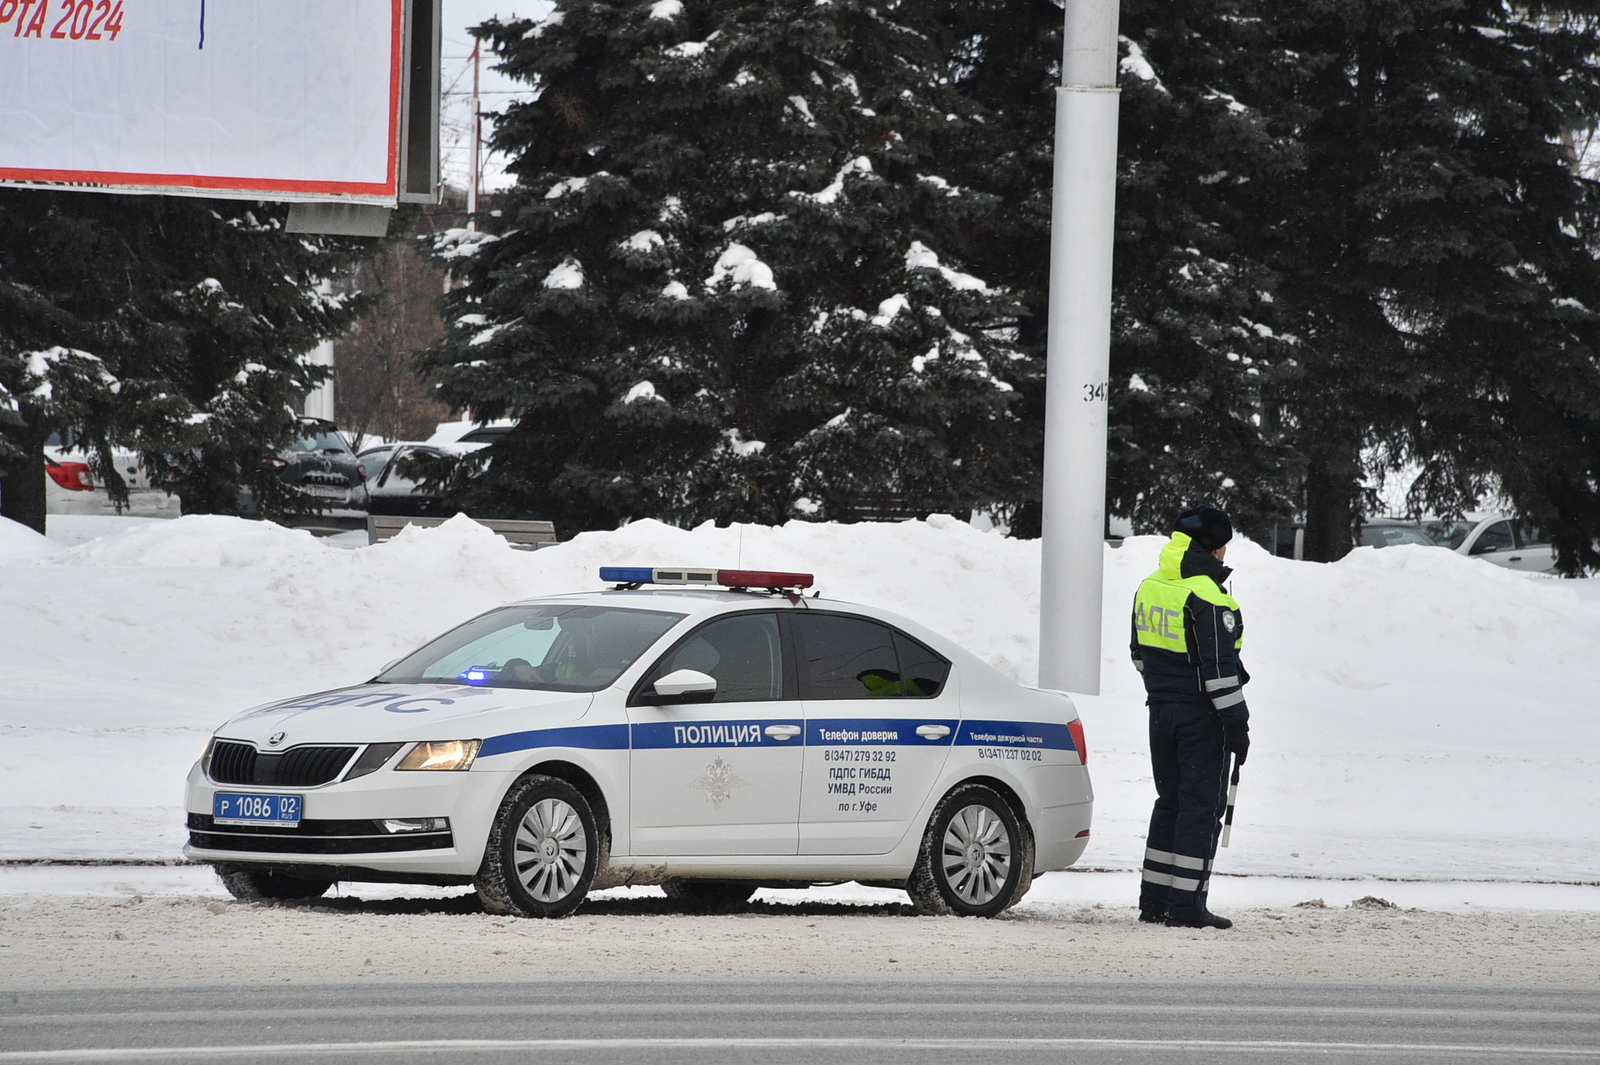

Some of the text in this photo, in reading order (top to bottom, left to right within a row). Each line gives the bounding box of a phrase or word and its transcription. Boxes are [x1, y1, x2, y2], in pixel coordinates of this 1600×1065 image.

[50, 0, 124, 41] 2024
[1136, 602, 1180, 640] ДПС
[674, 725, 761, 746] ПОЛИЦИЯ
[819, 728, 898, 743] Телефон доверия
[969, 732, 996, 742] Телефон
[998, 734, 1025, 743] дежурной
[873, 751, 883, 762] 32
[886, 751, 896, 762] 92
[829, 767, 891, 781] ПДПС ГИБДД
[828, 783, 892, 796] УМВД России
[236, 797, 271, 817] 1086
[280, 798, 296, 813] 02
[838, 801, 877, 813] по г. Уфе
[281, 812, 293, 820] RUS
